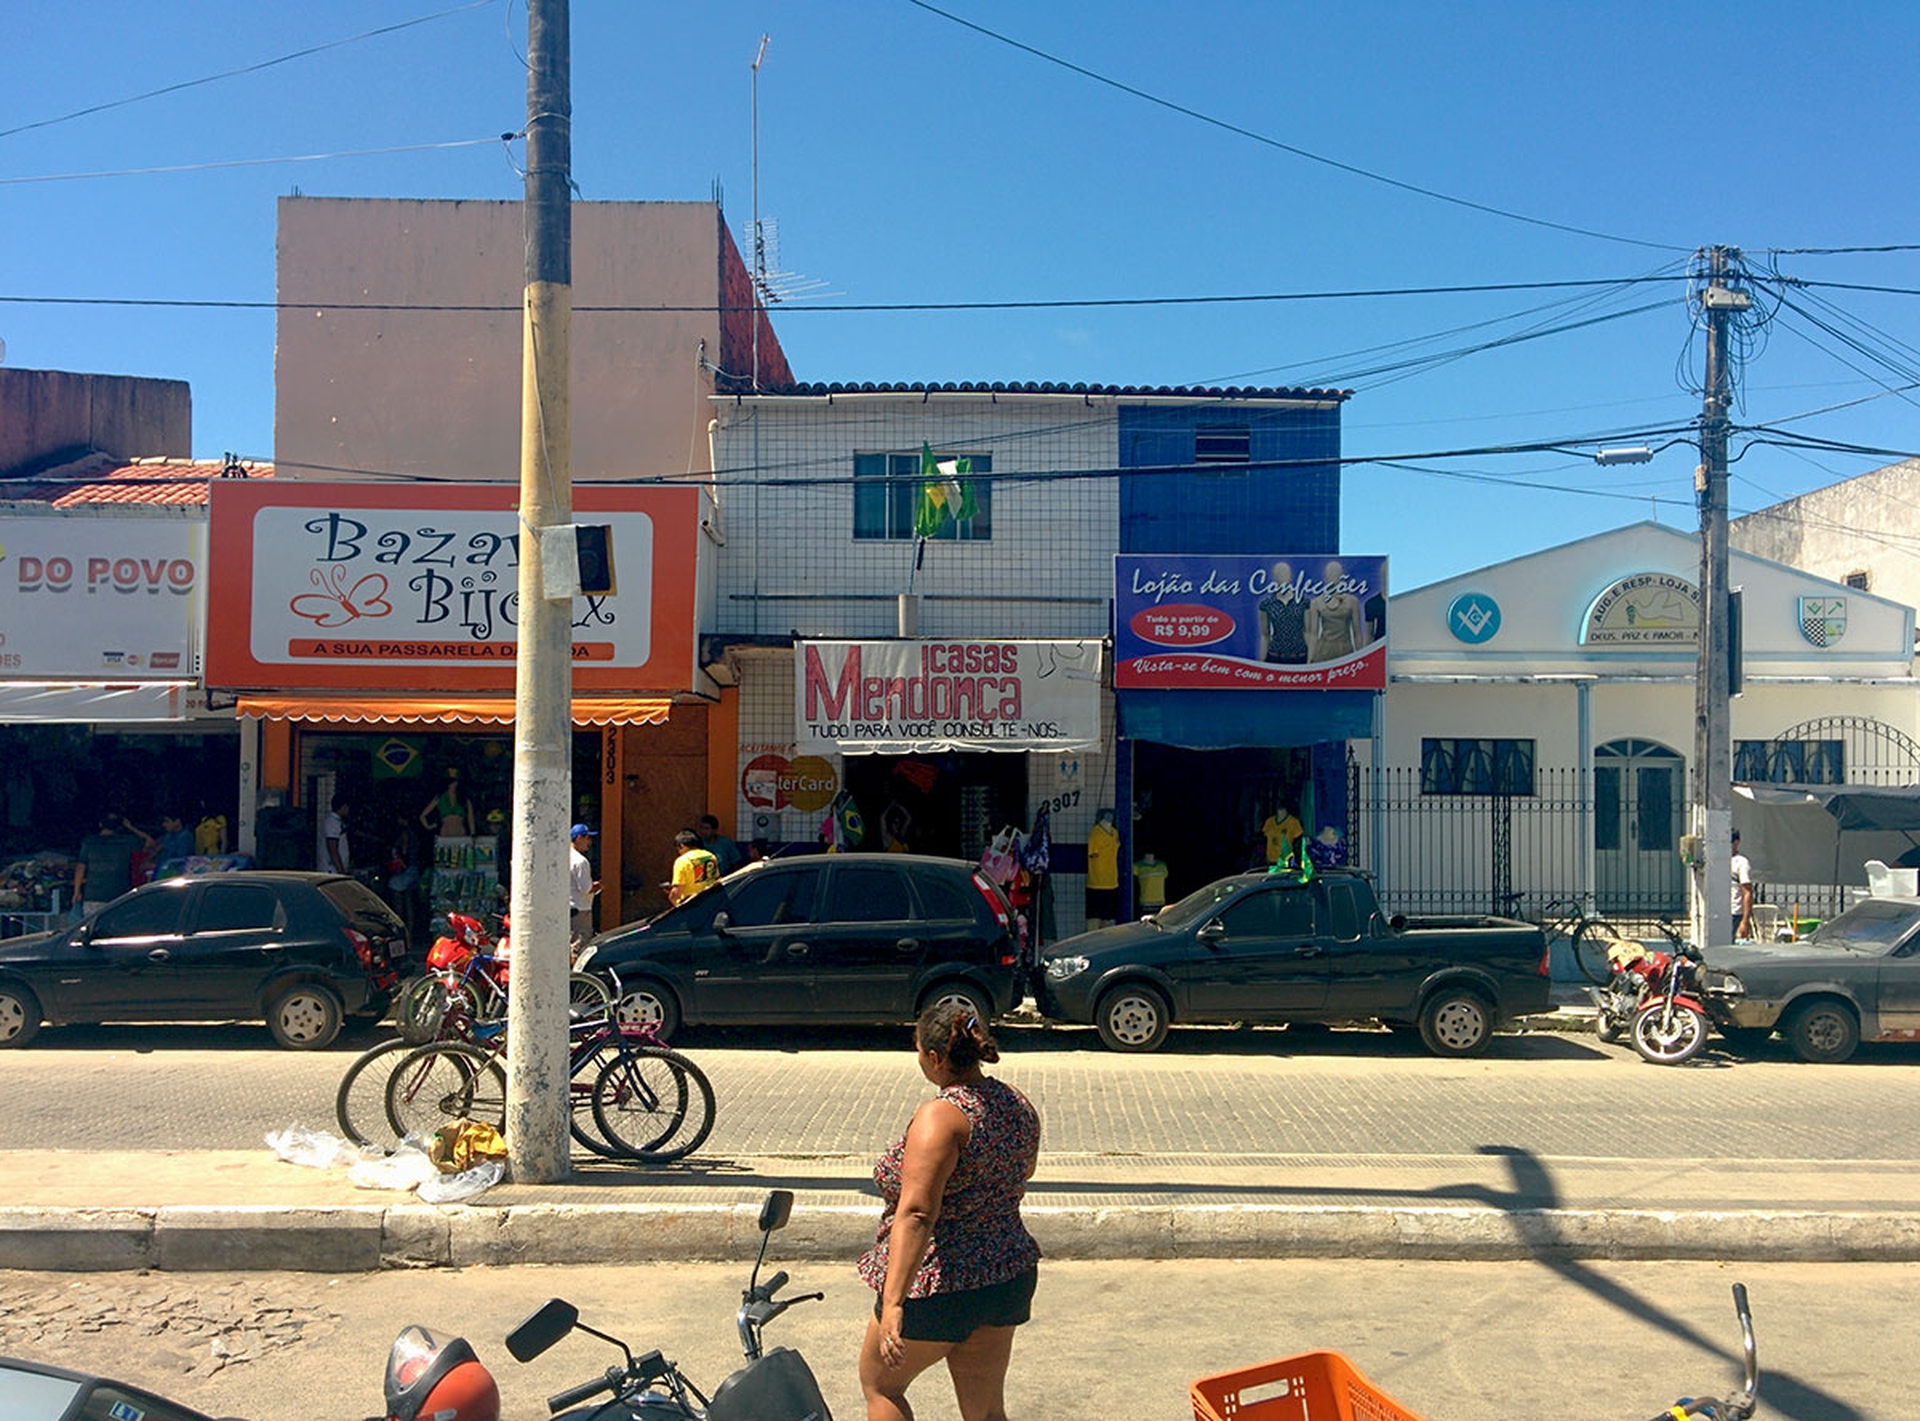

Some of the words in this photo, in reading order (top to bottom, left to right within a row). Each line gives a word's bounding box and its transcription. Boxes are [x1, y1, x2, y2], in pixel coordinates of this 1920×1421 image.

[18, 556, 74, 587] DO
[87, 557, 195, 588] POVO
[1131, 567, 1193, 604] Lojão
[1199, 569, 1241, 595] das
[1248, 568, 1369, 604] Confecções
[1659, 576, 1689, 594] LOJA
[408, 567, 616, 640] Bijx
[1154, 624, 1174, 637] R$
[1178, 624, 1211, 638] 9,99
[313, 642, 328, 654] A
[332, 642, 374, 655] SUA
[377, 642, 495, 657] PASSARELA
[500, 645, 518, 657] D
[929, 644, 1018, 674] casas
[1132, 658, 1198, 674] Vista-se
[1200, 658, 1230, 674] bem
[1234, 667, 1262, 681] com
[1265, 673, 1275, 683] o
[1278, 672, 1323, 684] menor
[804, 644, 1022, 728] Mendonça
[808, 723, 849, 738] TUDO
[854, 723, 893, 738] PARA
